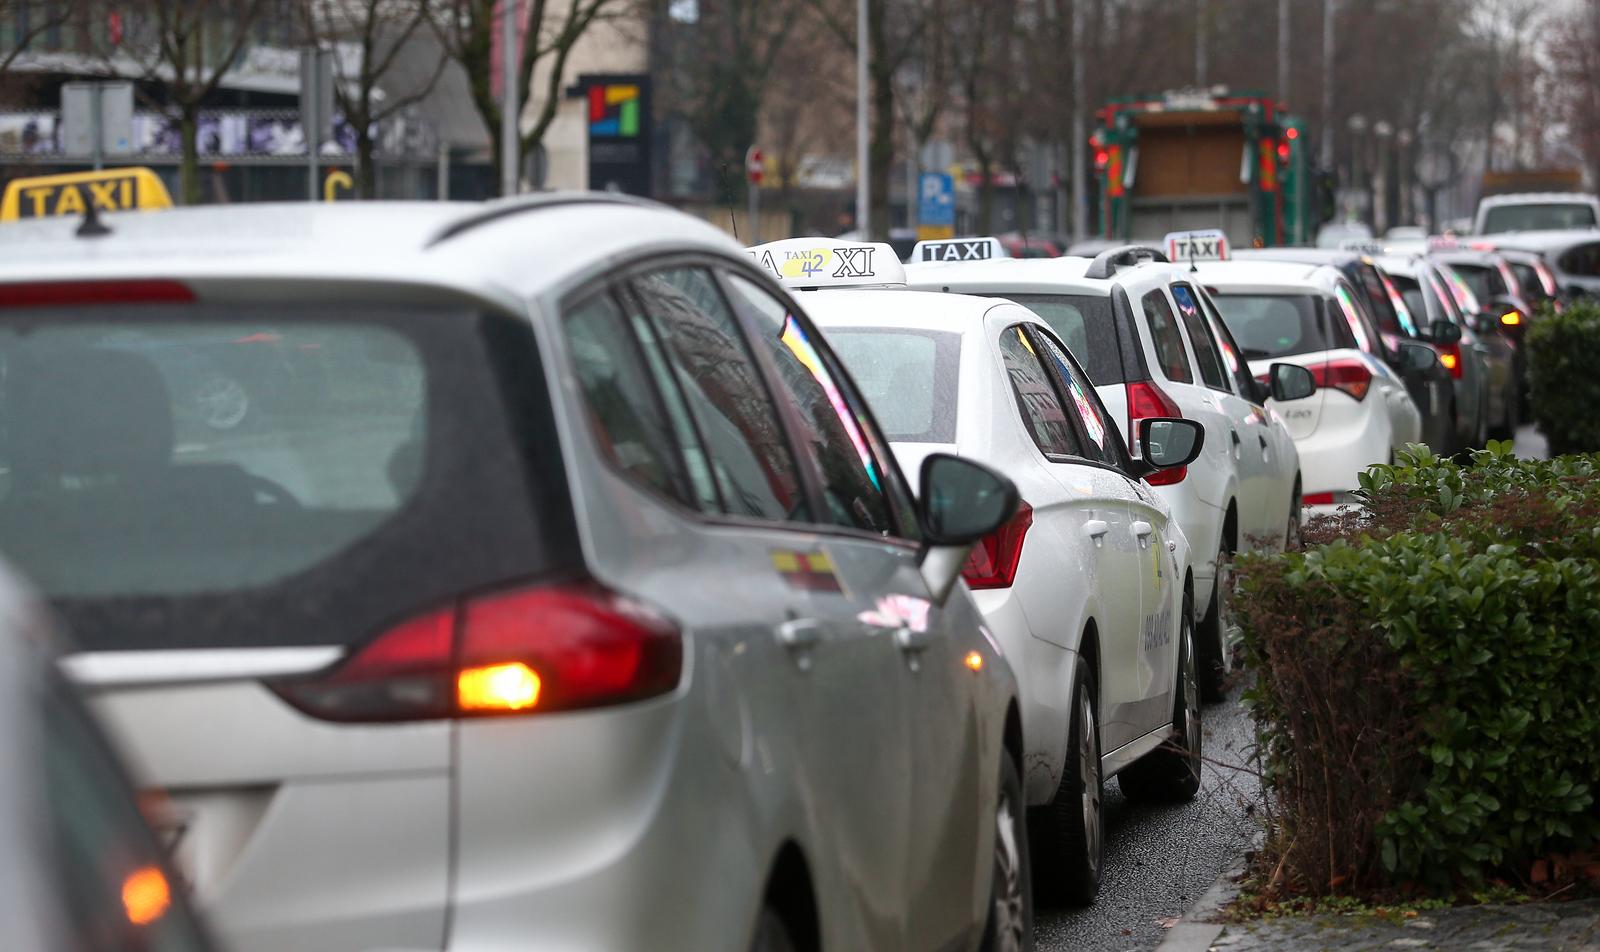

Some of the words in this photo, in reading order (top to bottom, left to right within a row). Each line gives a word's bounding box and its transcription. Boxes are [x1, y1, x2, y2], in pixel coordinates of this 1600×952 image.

[25, 178, 133, 217] TAXI
[784, 250, 812, 260] TAXI
[925, 241, 989, 261] TAXI
[1176, 241, 1220, 256] TAXI
[745, 249, 783, 280] A
[801, 254, 824, 278] 42
